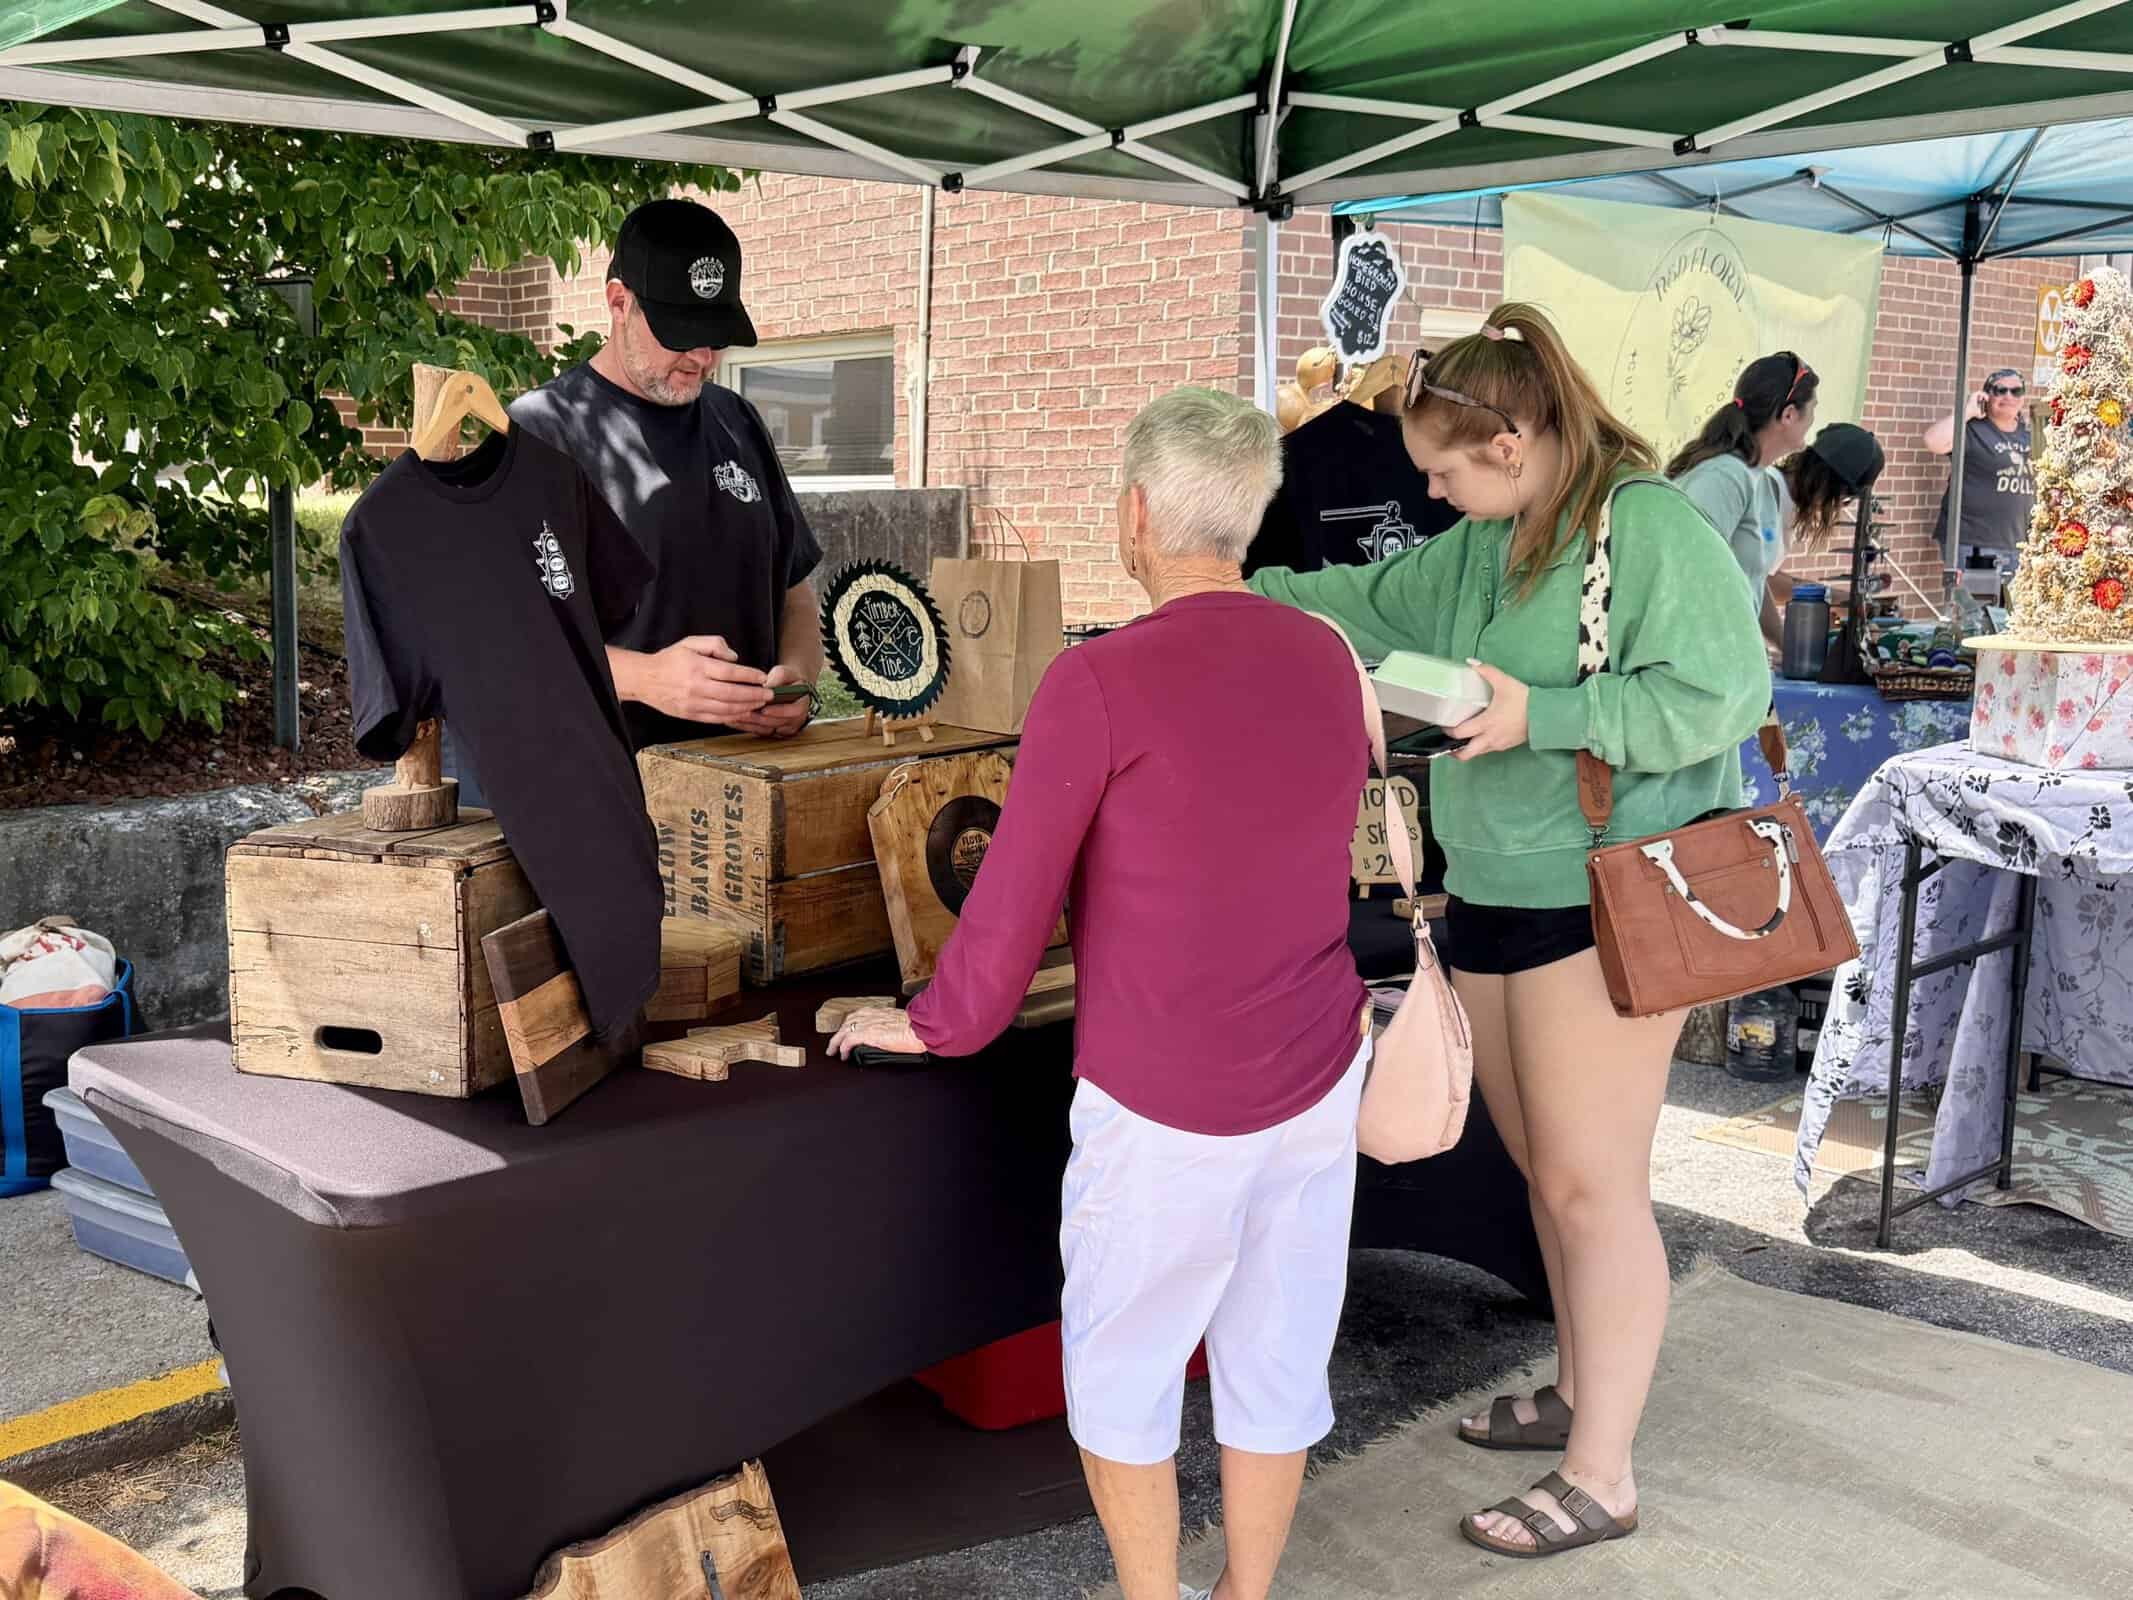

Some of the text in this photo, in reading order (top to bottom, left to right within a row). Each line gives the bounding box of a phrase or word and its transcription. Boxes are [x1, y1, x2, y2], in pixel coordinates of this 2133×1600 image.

[1344, 280, 1377, 312] HOUSE
[1355, 270, 1377, 291] BIRD
[658, 821, 677, 917] ELLOW
[691, 807, 709, 916] BANKS
[724, 783, 743, 902] GROVES
